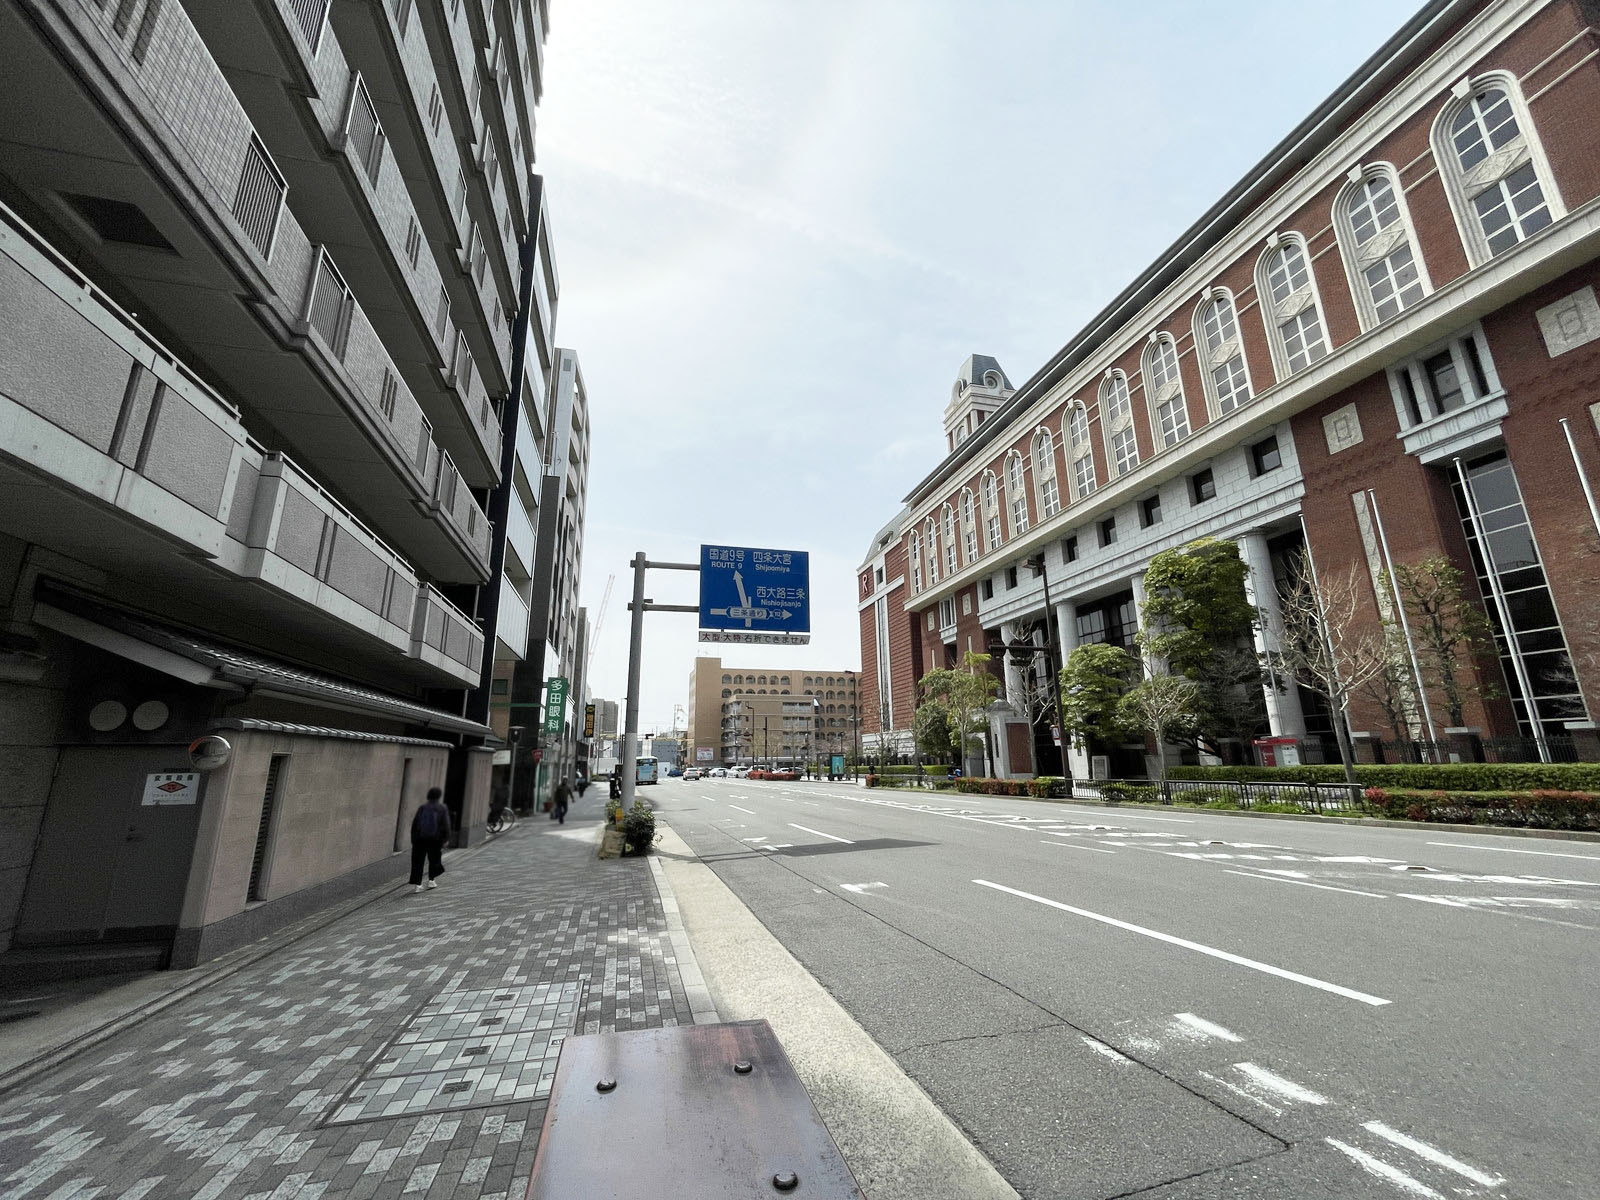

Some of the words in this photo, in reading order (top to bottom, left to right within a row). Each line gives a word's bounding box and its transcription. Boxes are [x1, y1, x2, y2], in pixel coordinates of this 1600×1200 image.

[709, 548, 745, 562] 国道9号
[753, 551, 792, 565] 四条大宮
[711, 561, 736, 569] ROUTE
[755, 564, 790, 573] Shijoomiya
[862, 573, 868, 593] R
[756, 586, 806, 600] 西大路三条
[761, 599, 801, 608] Nishiojisanjo
[732, 608, 764, 618] 三条通り
[547, 679, 563, 731] 多田眼科
